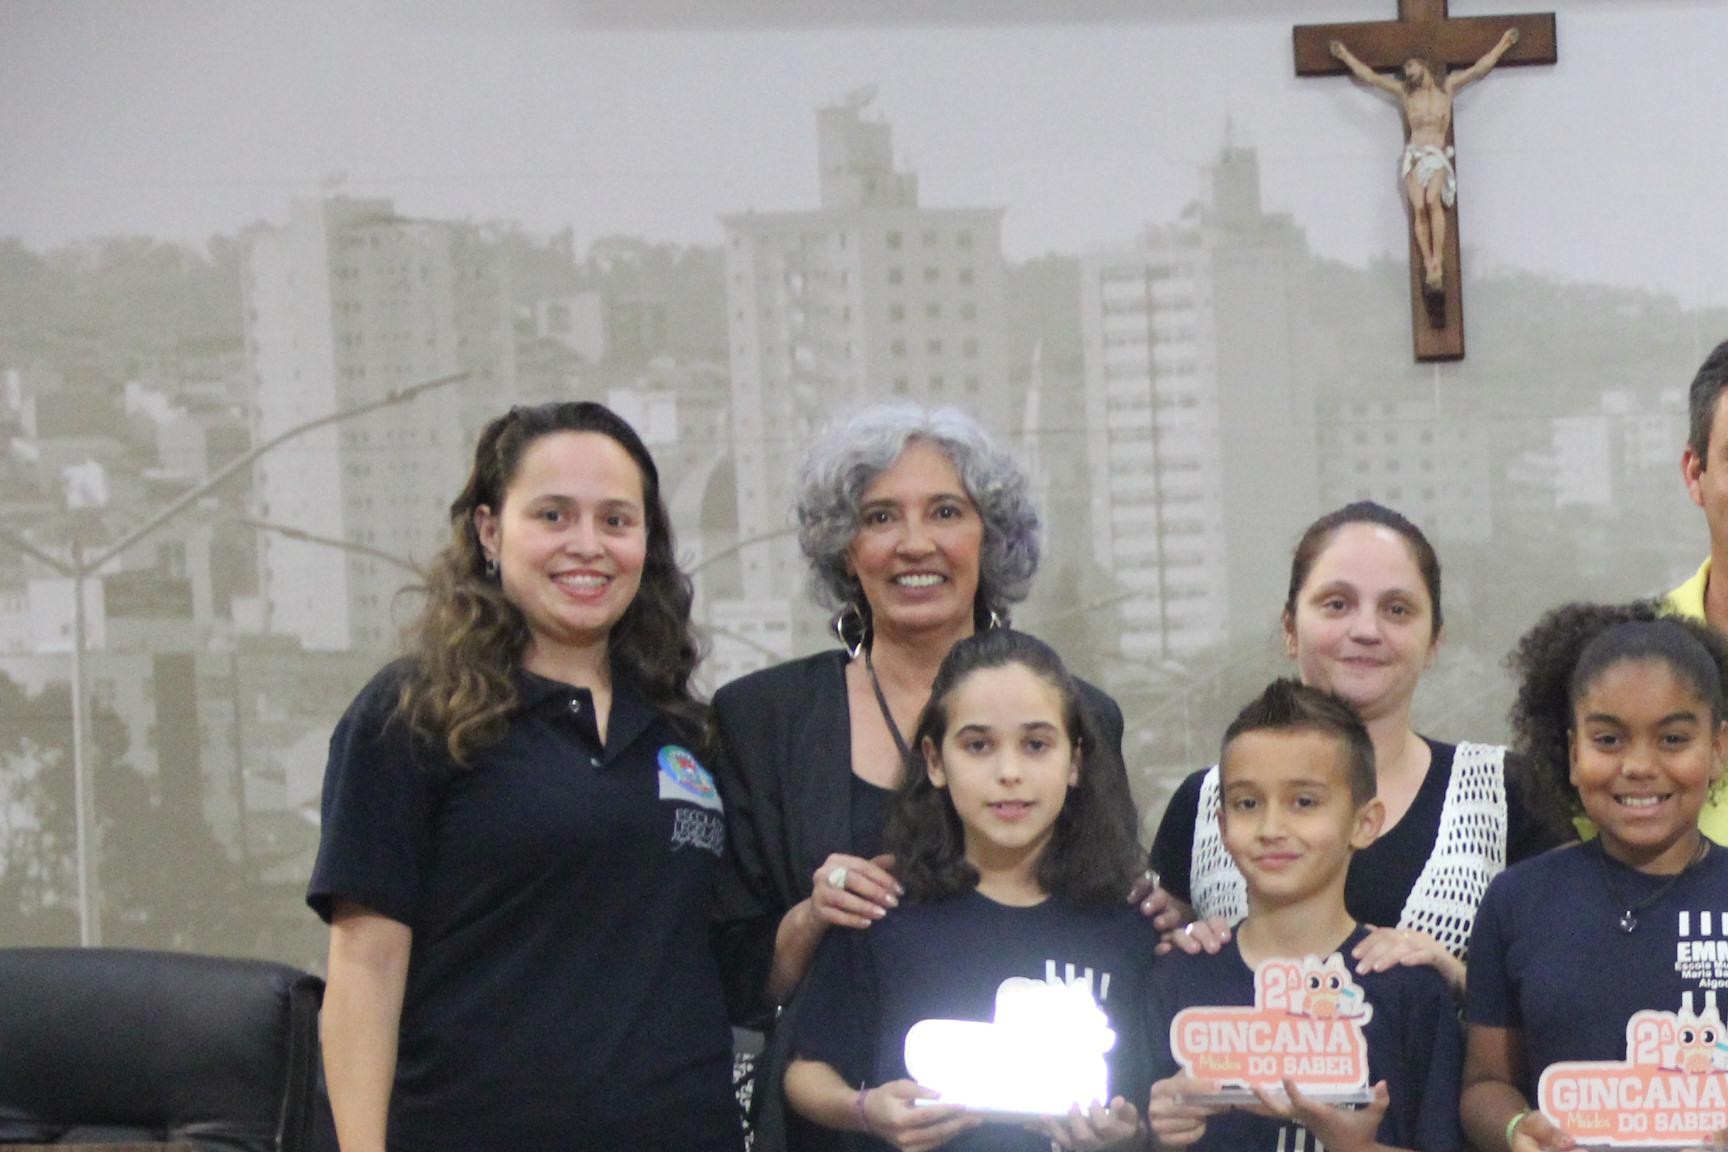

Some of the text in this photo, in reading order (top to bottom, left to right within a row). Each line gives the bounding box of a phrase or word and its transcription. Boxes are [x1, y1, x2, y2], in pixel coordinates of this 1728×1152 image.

[1675, 961, 1712, 972] Escola
[1682, 970, 1712, 979] Maria
[1184, 1020, 1352, 1054] GINCANA
[1249, 1056, 1277, 1075] DO
[1283, 1055, 1354, 1076] SABER
[1552, 1077, 1726, 1110] GINCANA
[1618, 1113, 1648, 1133] DO
[1655, 1112, 1727, 1132] SABER
